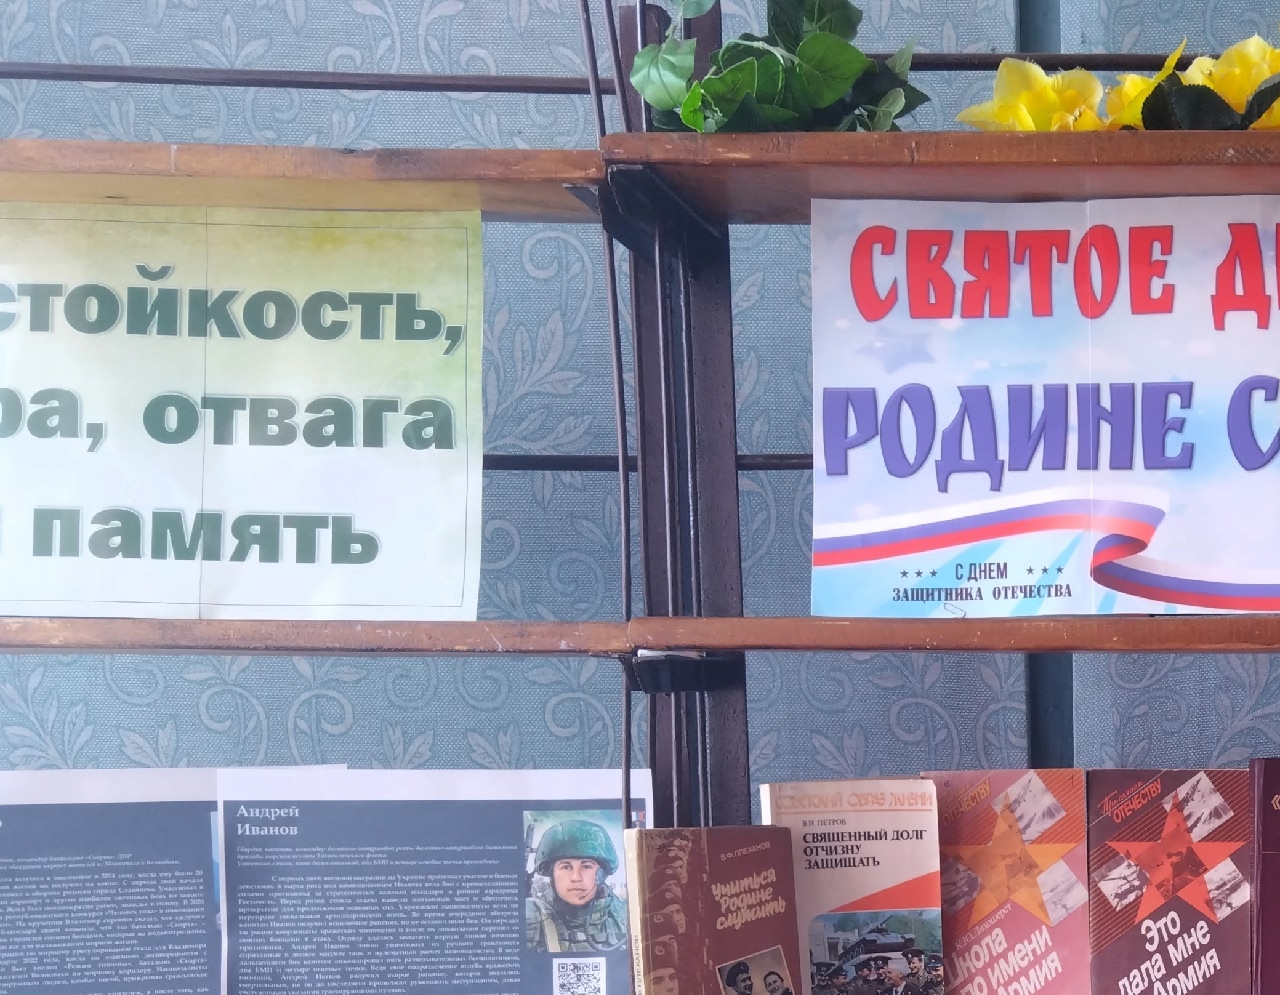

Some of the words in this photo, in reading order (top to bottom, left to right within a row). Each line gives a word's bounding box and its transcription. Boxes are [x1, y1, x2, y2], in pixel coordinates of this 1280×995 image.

[850, 224, 1175, 322] СВЯТОЕ
[143, 391, 455, 450] отвага
[822, 381, 1195, 493] РОДИНЕ
[33, 506, 380, 565] память
[892, 585, 984, 605] ЗАЩИТНИКА
[992, 584, 1073, 601] ОТЕЧЕСТВА
[236, 805, 300, 820] Андрей
[1113, 778, 1161, 823] ОТЕЧЕСТВУ
[236, 823, 298, 836] Иванов
[803, 828, 888, 844] СВЯЩЕННЫЙ
[890, 829, 927, 842] ДОЛГ
[817, 819, 847, 827] ПЕТРОВ
[803, 844, 862, 857] ОТЧИЗНУ
[804, 856, 880, 870] ЗАЩИЩАТЬ
[1140, 911, 1181, 952] Это
[1169, 920, 1211, 966] мне
[987, 925, 1053, 990] имени
